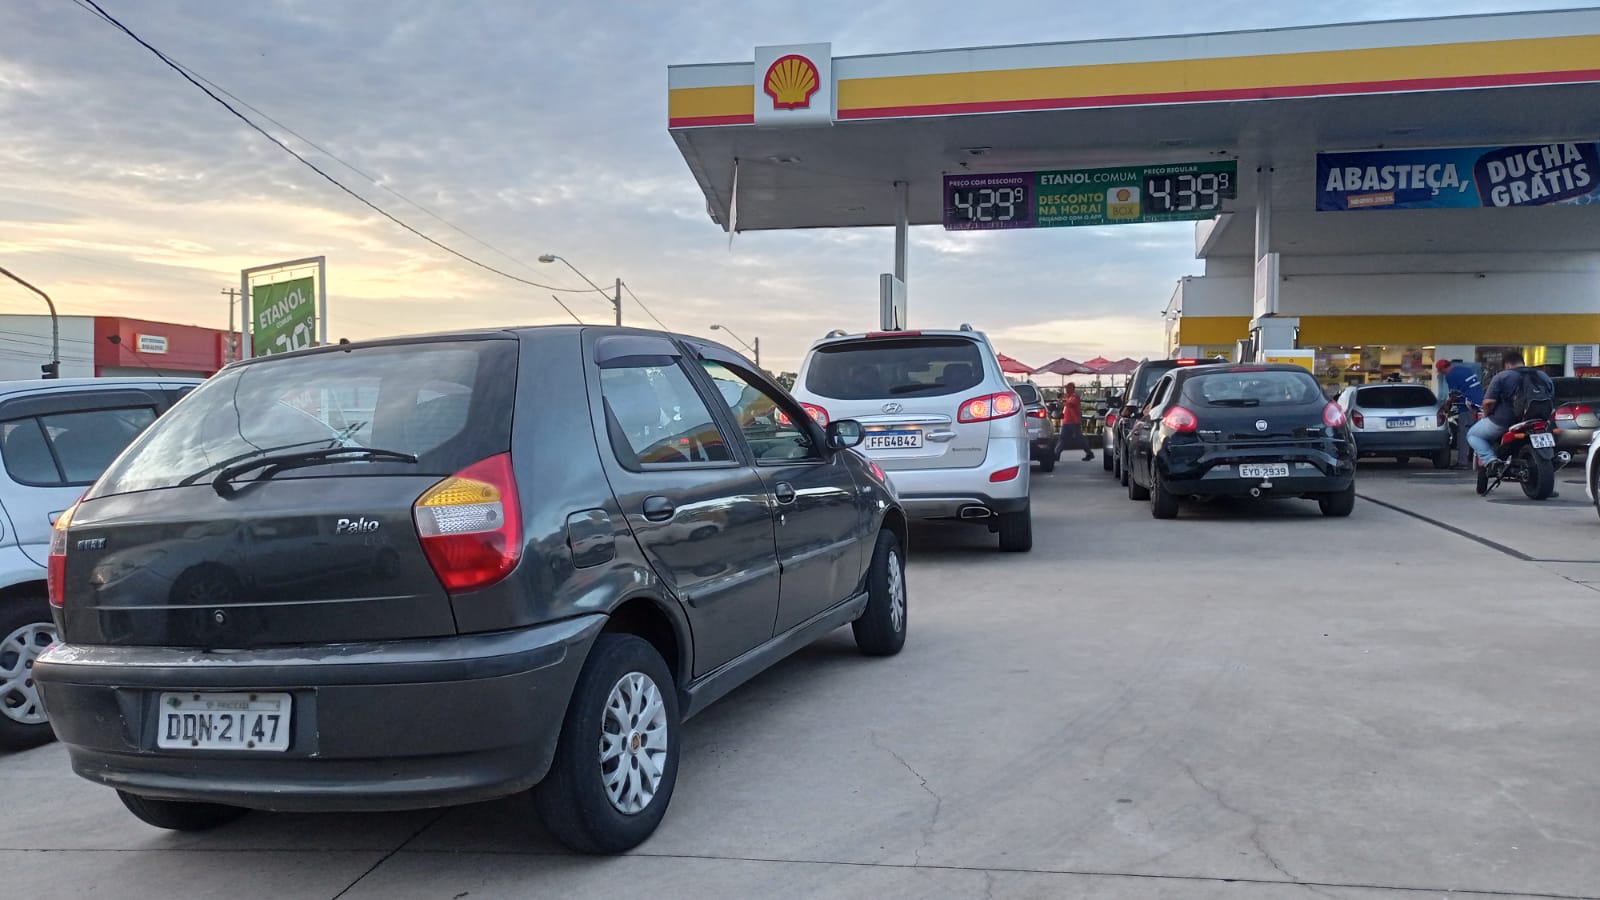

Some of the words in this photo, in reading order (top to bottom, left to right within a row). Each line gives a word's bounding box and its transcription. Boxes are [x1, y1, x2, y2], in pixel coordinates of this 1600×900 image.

[1487, 143, 1582, 184] DUCHA
[1041, 173, 1090, 185] ETANOL
[1093, 172, 1137, 183] COMUM
[1325, 163, 1469, 196] ABASTEÇA,
[1491, 163, 1591, 207] GRÁTIS
[1039, 193, 1104, 205] DESCONTO
[1039, 206, 1057, 215] NA
[1061, 204, 1101, 214] HORA!
[1113, 206, 1134, 216] BOX
[259, 288, 306, 329] ETANOL
[871, 436, 917, 447] FFG4B42
[336, 517, 379, 534] Palio
